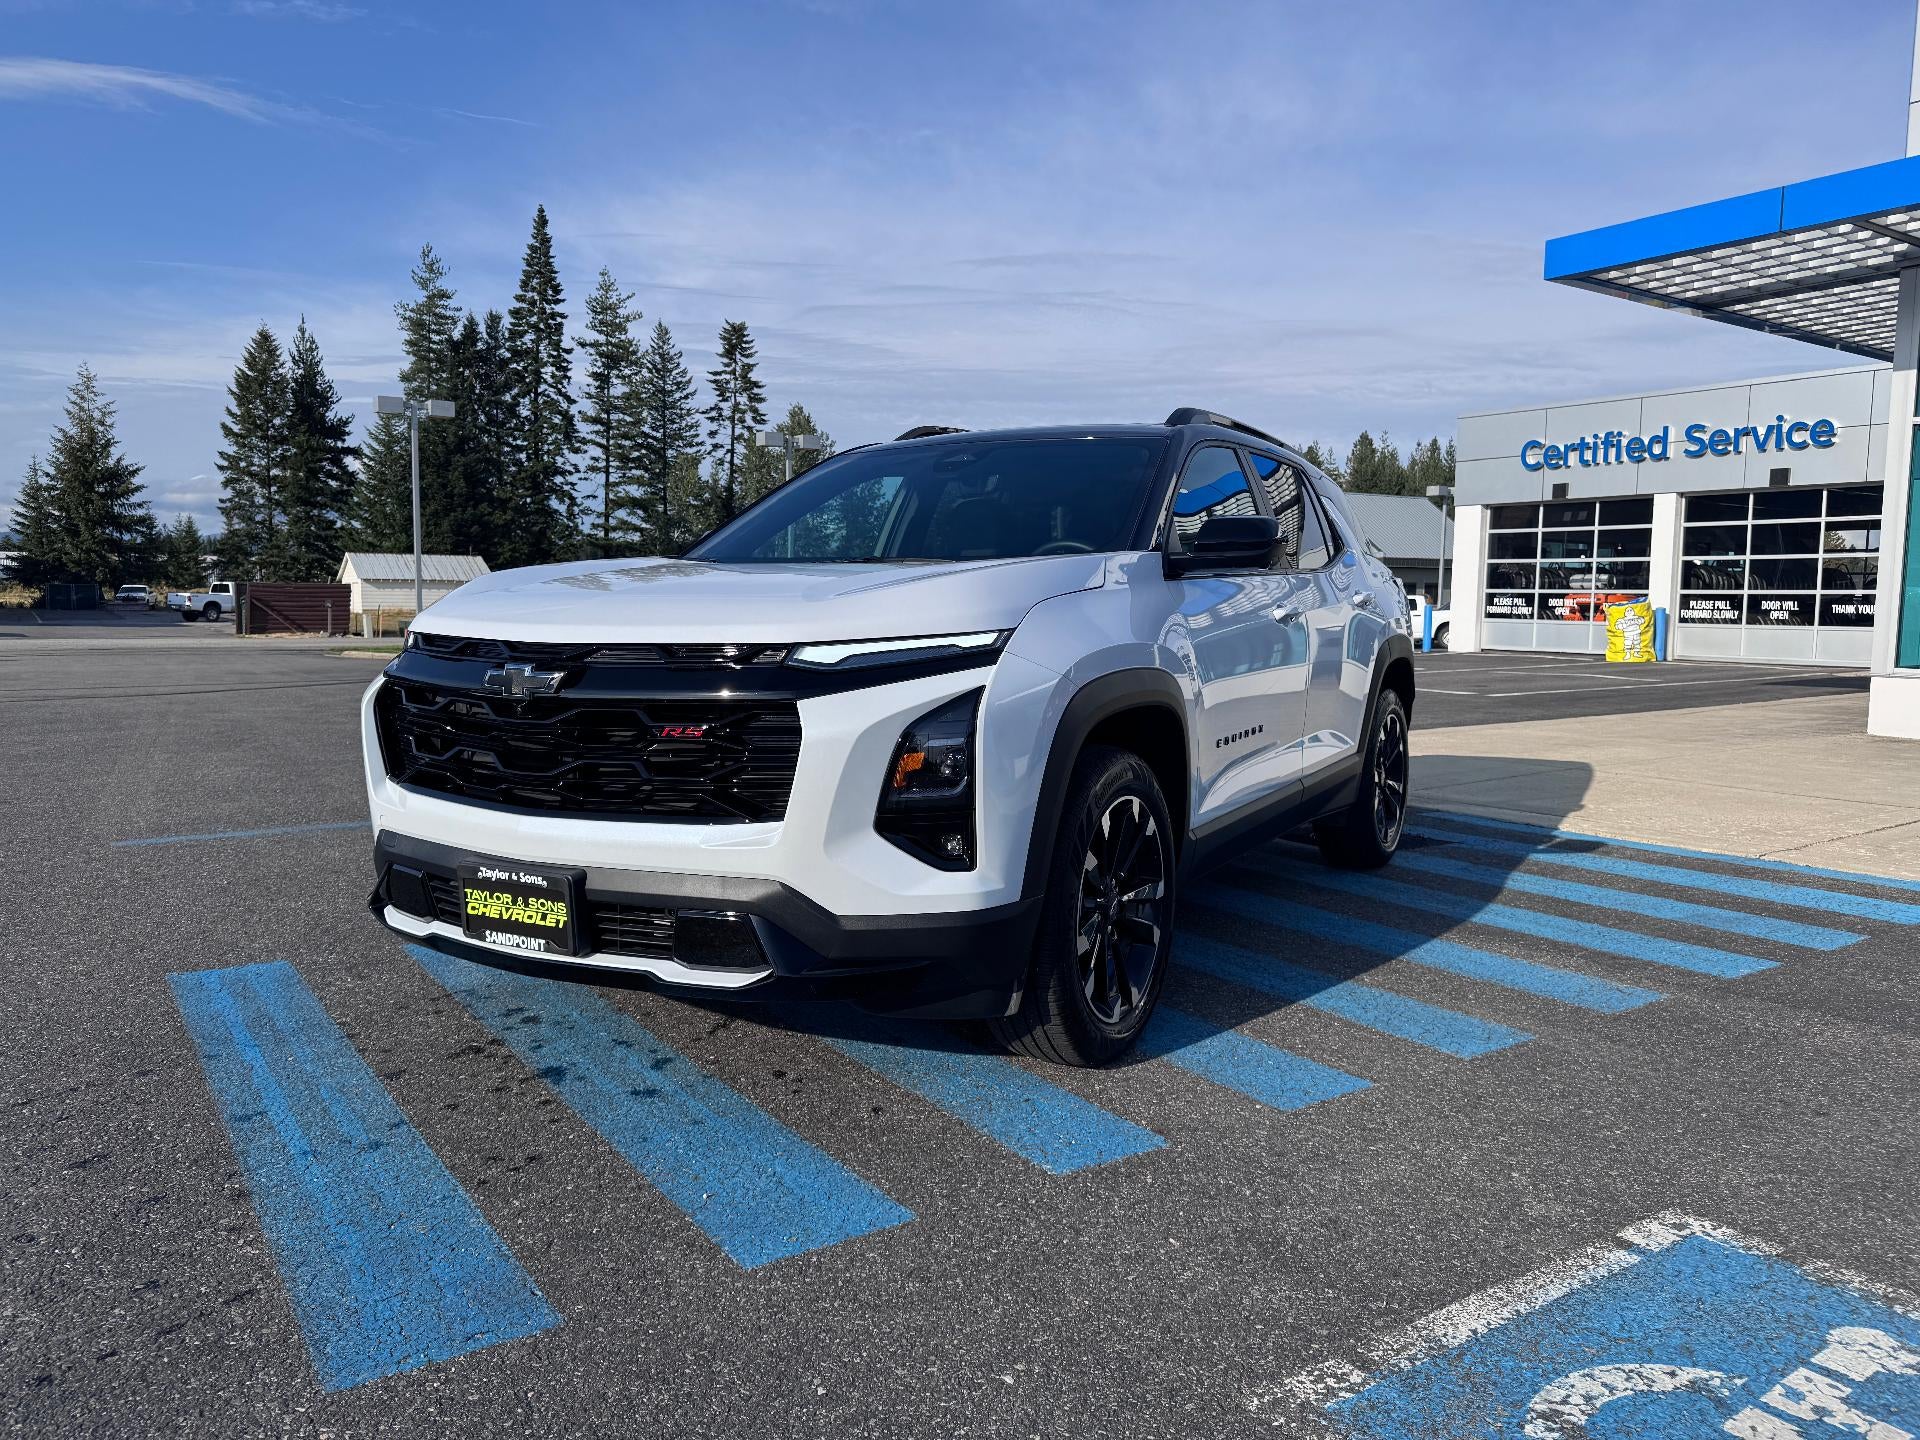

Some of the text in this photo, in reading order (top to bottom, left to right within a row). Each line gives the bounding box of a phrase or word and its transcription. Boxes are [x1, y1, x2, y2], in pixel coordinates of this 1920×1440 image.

[1520, 414, 1837, 471] Certified Service
[1493, 597, 1526, 606] PLEASE PULL
[1548, 599, 1563, 607] DOOR
[1690, 600, 1731, 609] PLEASE PULL
[1761, 601, 1799, 610] DOOR WILL
[1486, 606, 1533, 615] FORWARD SLOWLY
[1555, 607, 1570, 616] OPEN
[1680, 609, 1739, 619] FORWARD SLOWLY
[1832, 605, 1856, 614] THANK
[1769, 611, 1789, 619] OPEN
[661, 726, 704, 737] RS
[480, 867, 509, 881] Taylor
[519, 872, 543, 885] Sons
[464, 888, 567, 914] TAYLOR & SONS
[466, 902, 568, 929] CHEVROLET
[485, 929, 546, 951] SANDPOINT
